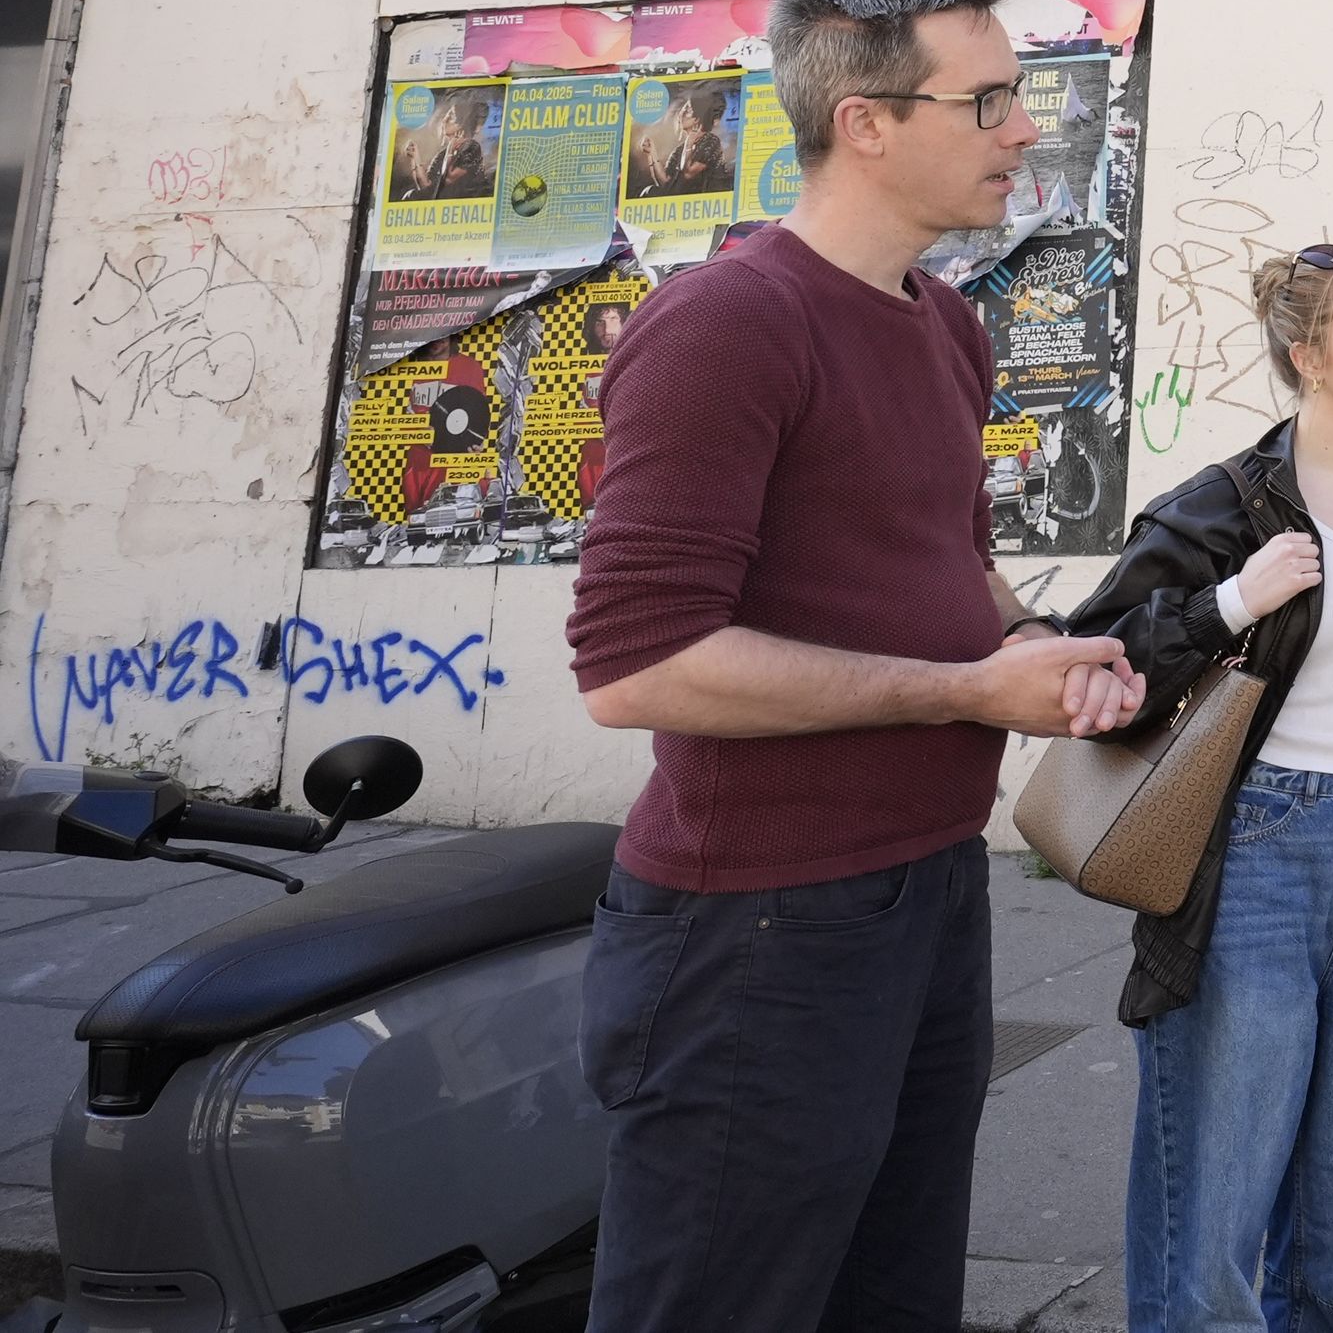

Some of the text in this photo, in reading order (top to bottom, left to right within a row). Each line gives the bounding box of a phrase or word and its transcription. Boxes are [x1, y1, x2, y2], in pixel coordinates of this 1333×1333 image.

[641, 4, 694, 16] ELEVATE
[472, 14, 524, 26] ELEVATE
[1031, 70, 1060, 89] EINE
[512, 83, 622, 103] 04.04.2025 Flucc
[636, 89, 665, 100] Salam
[635, 99, 663, 109] Music
[508, 101, 620, 132] SALAM CLUB
[581, 142, 611, 155] LINEUP
[385, 201, 493, 228] GHALIA BENALI
[623, 198, 730, 225] GHALIA BENAL
[382, 230, 491, 245] 03.04.2025 Theater Akzent
[375, 295, 484, 312] NUR PFERDEN GIBT MAN
[591, 293, 607, 303] TAXI
[372, 311, 477, 332] DEN GNADENSCHUSS
[1050, 322, 1087, 333] LOOSE
[1009, 331, 1086, 343] TATIANA FELIX
[1010, 339, 1083, 351] JP BECHAMEL
[1010, 346, 1083, 359] SPINACHJAZZ
[996, 353, 1097, 368] ZEUS DOPPELKORN
[1028, 368, 1062, 376] THURS
[1035, 371, 1072, 381] MARCH
[1017, 387, 1072, 395] PRATERSTRASSE
[354, 402, 385, 412] FILLY
[527, 397, 557, 407] FILLY
[353, 416, 427, 426] ANNI HERZER
[526, 412, 553, 421] ANNI
[988, 424, 1034, 436] 7. MÄRZ
[351, 432, 432, 443] PRODBYPENGG
[985, 443, 1019, 453] 23:00
[451, 456, 462, 465] 7.
[464, 453, 496, 464] MÄRZ
[448, 470, 480, 481] 23:00
